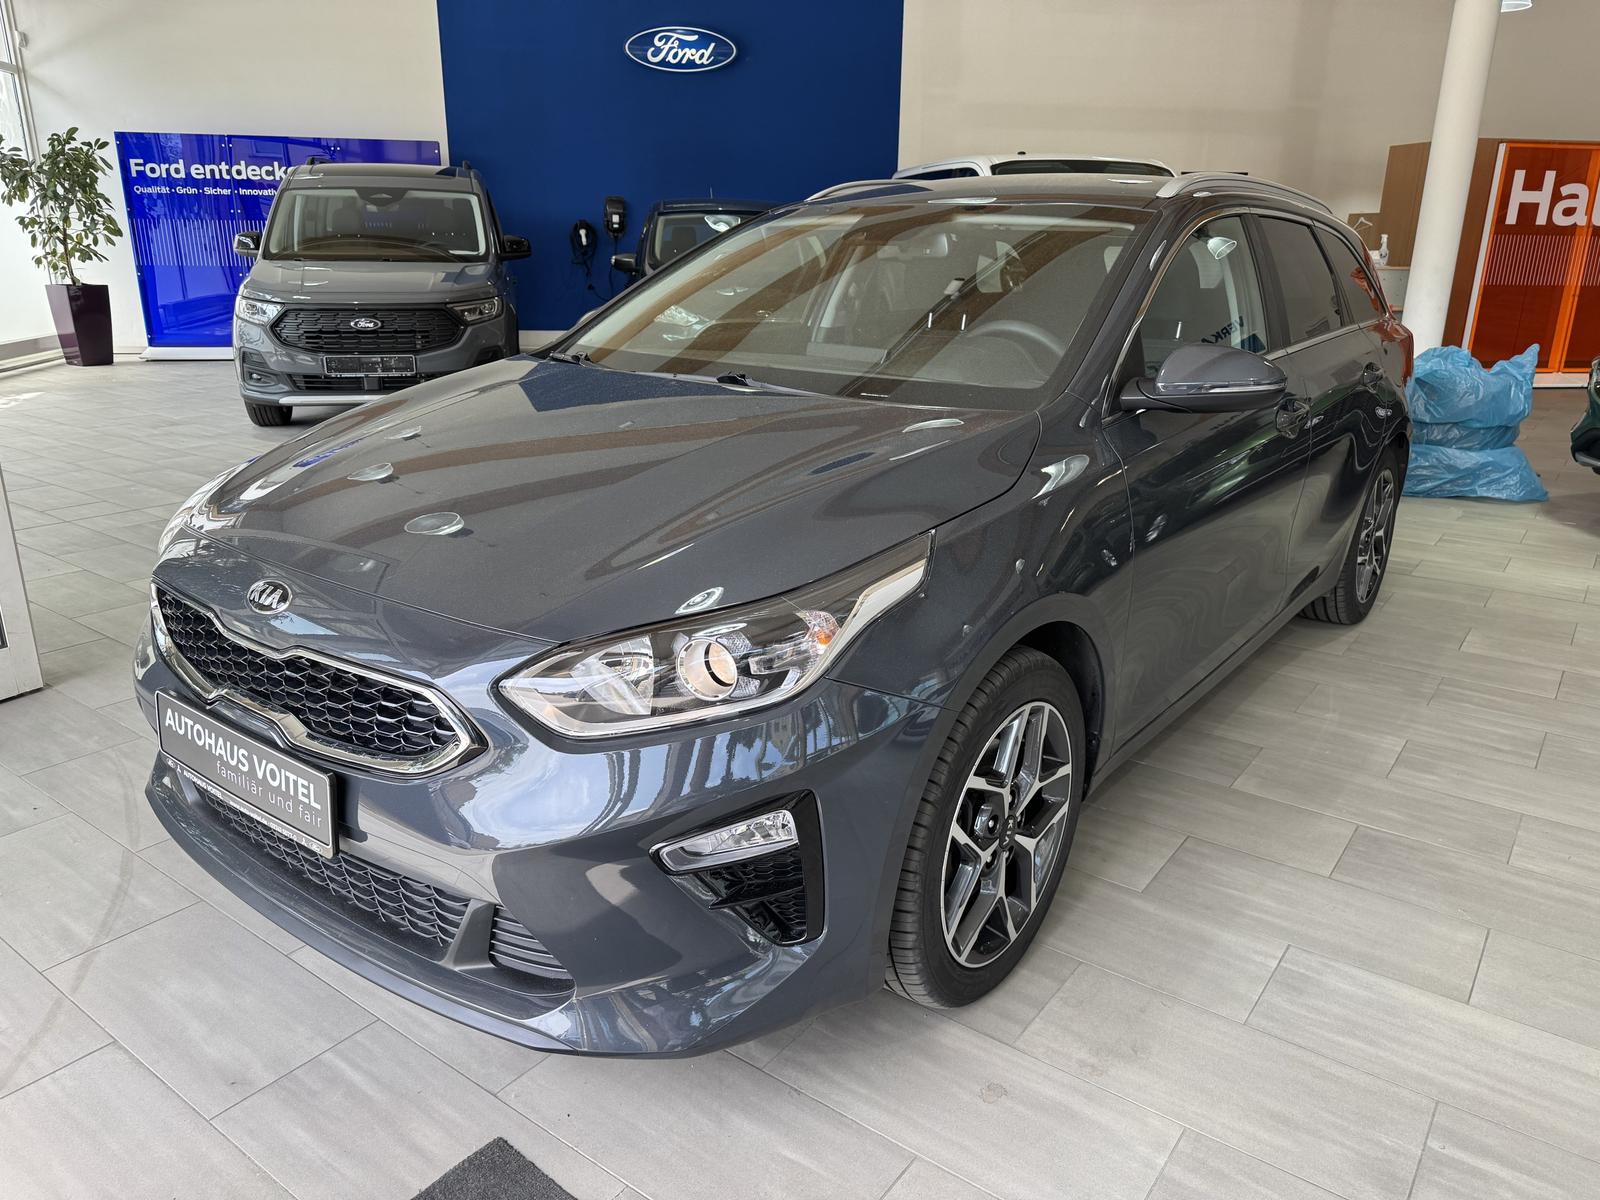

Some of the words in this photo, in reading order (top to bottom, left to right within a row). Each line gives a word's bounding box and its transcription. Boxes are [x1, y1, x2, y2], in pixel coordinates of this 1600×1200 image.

[647, 32, 716, 65] Ford
[129, 158, 186, 179] Ford
[134, 185, 171, 195] Qualität
[176, 186, 198, 195] Grün
[203, 187, 232, 196] Sicher
[249, 582, 284, 610] KIA
[165, 708, 249, 772] AUTOHAUS
[253, 754, 321, 810] VOITEL
[216, 760, 264, 798] familiär
[268, 791, 294, 814] und
[299, 804, 323, 829] fair
[1003, 819, 1014, 846] KIA
